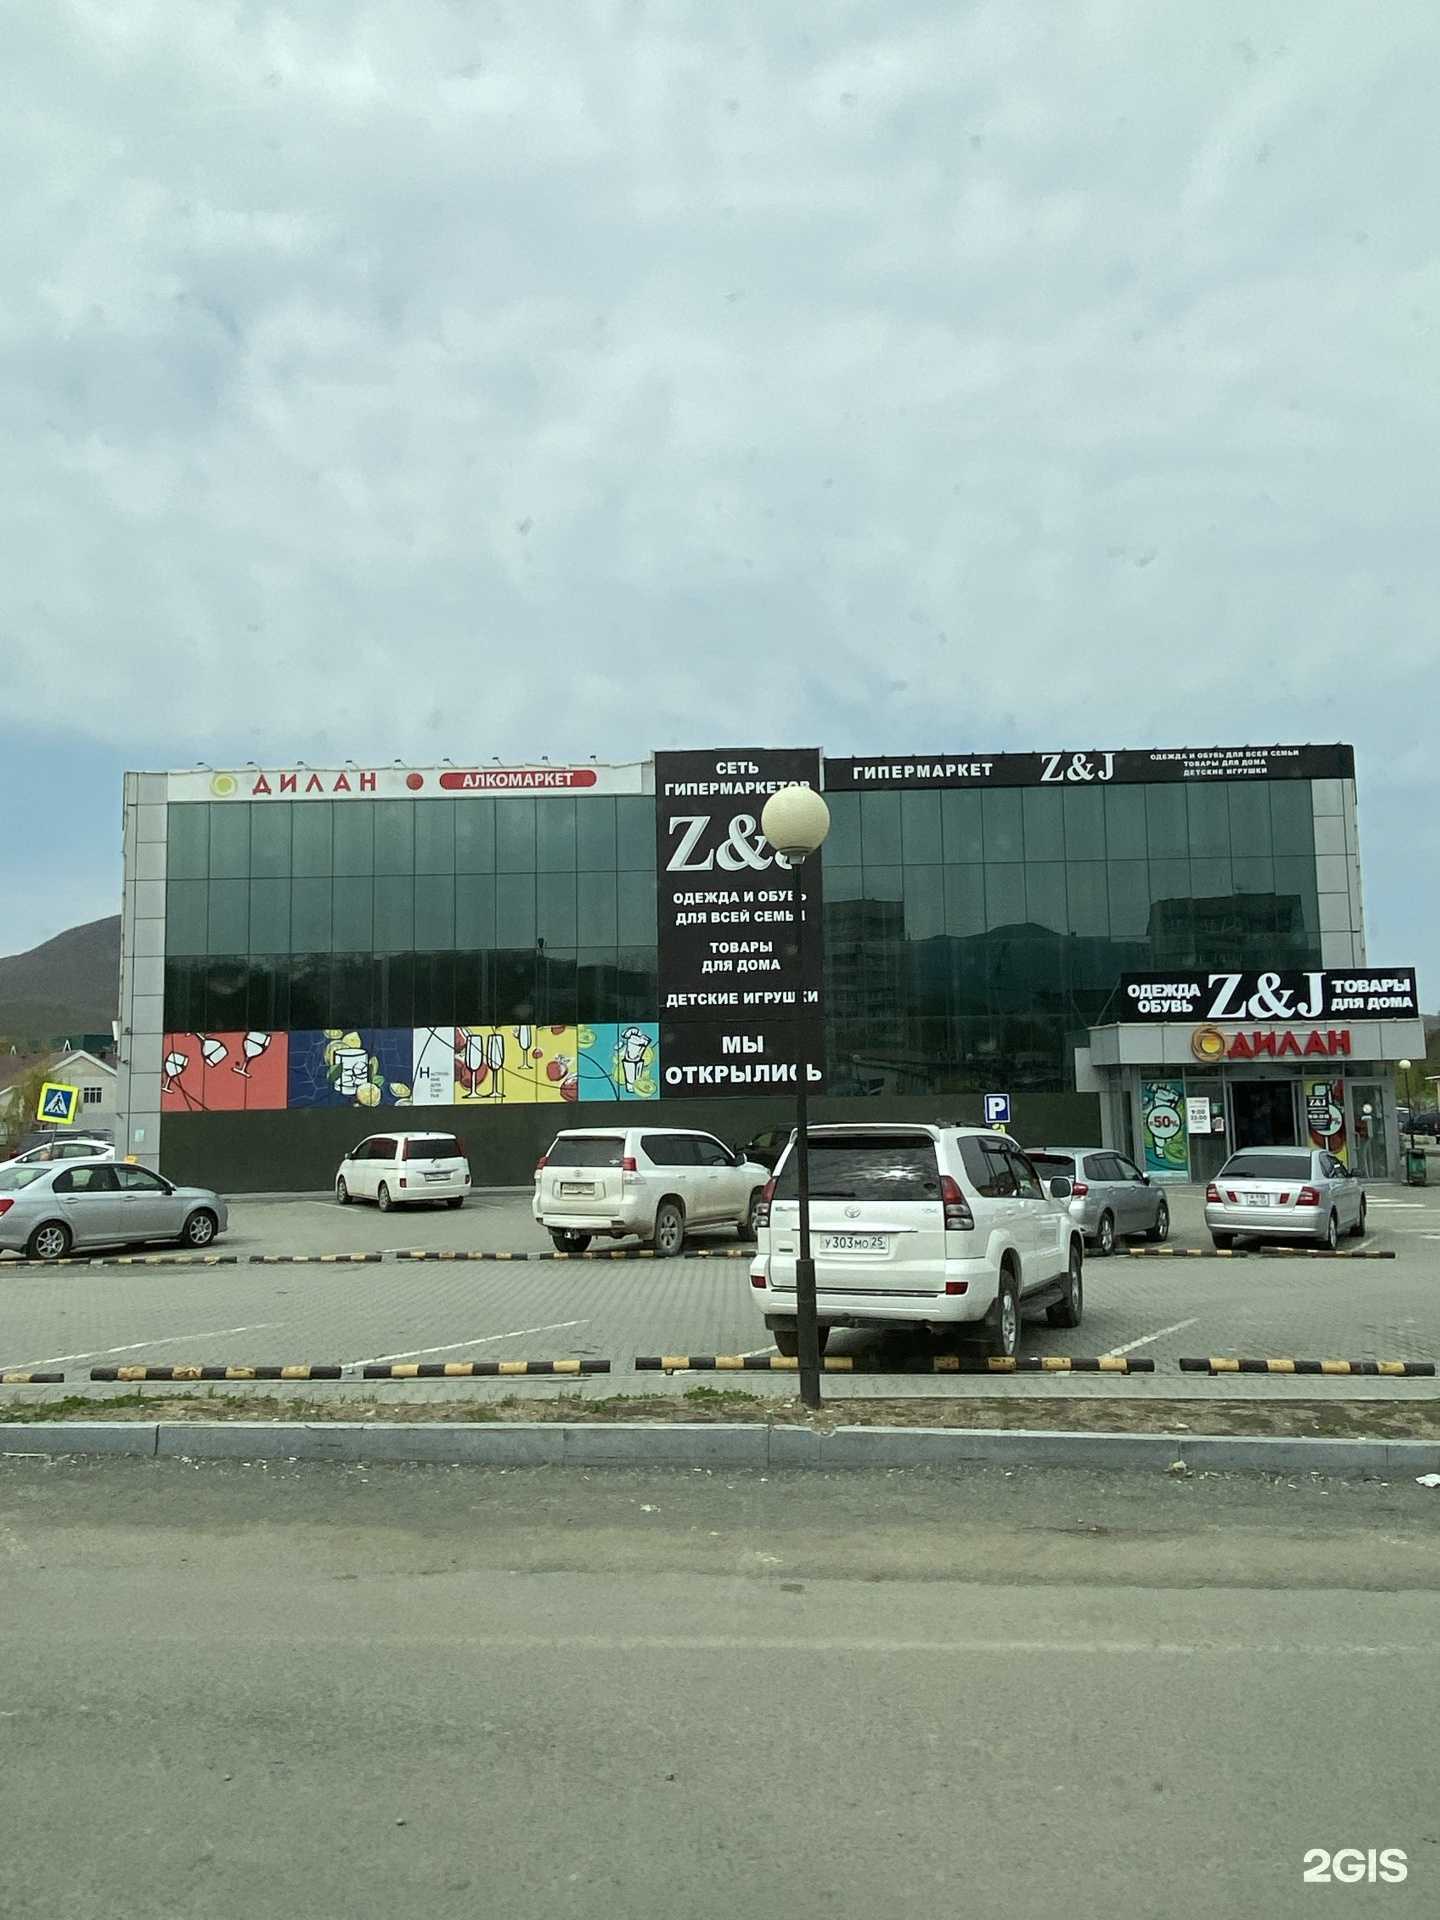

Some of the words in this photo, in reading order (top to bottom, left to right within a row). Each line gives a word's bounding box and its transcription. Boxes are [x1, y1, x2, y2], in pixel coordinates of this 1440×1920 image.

[716, 761, 760, 775] СЕТЬ
[853, 763, 993, 780] ГИПЕРМАРКЕТ
[1040, 753, 1116, 783] Z&J
[1183, 768, 1224, 776] ДЕТСКИЕ
[1226, 767, 1268, 775] ИГРУШКИ
[252, 772, 376, 795] ДИЛАН
[462, 772, 575, 788] АЛКОМАРКЕТ
[666, 814, 806, 872] Z&
[673, 891, 740, 905] ОДЕЖДА
[744, 891, 754, 902] И
[675, 912, 707, 926] ДЛЯ
[711, 910, 750, 924] ВСЕЙ
[709, 941, 773, 954] ТОВАРЫ
[701, 960, 733, 974] ДЛЯ
[737, 959, 781, 973] ДОМА
[1127, 984, 1201, 999] ОДЕЖДА
[1331, 979, 1411, 993] ТОВАРЫ
[666, 993, 739, 1008] ДЕТСКИЕ
[1206, 972, 1327, 1019] Z&J
[1137, 1000, 1194, 1014] ОБУВЬ
[1331, 997, 1365, 1011] ДЛЯ
[1367, 996, 1413, 1010] ДОМА
[722, 1036, 764, 1054] МЫ
[1227, 1030, 1351, 1060] ДИЛАН
